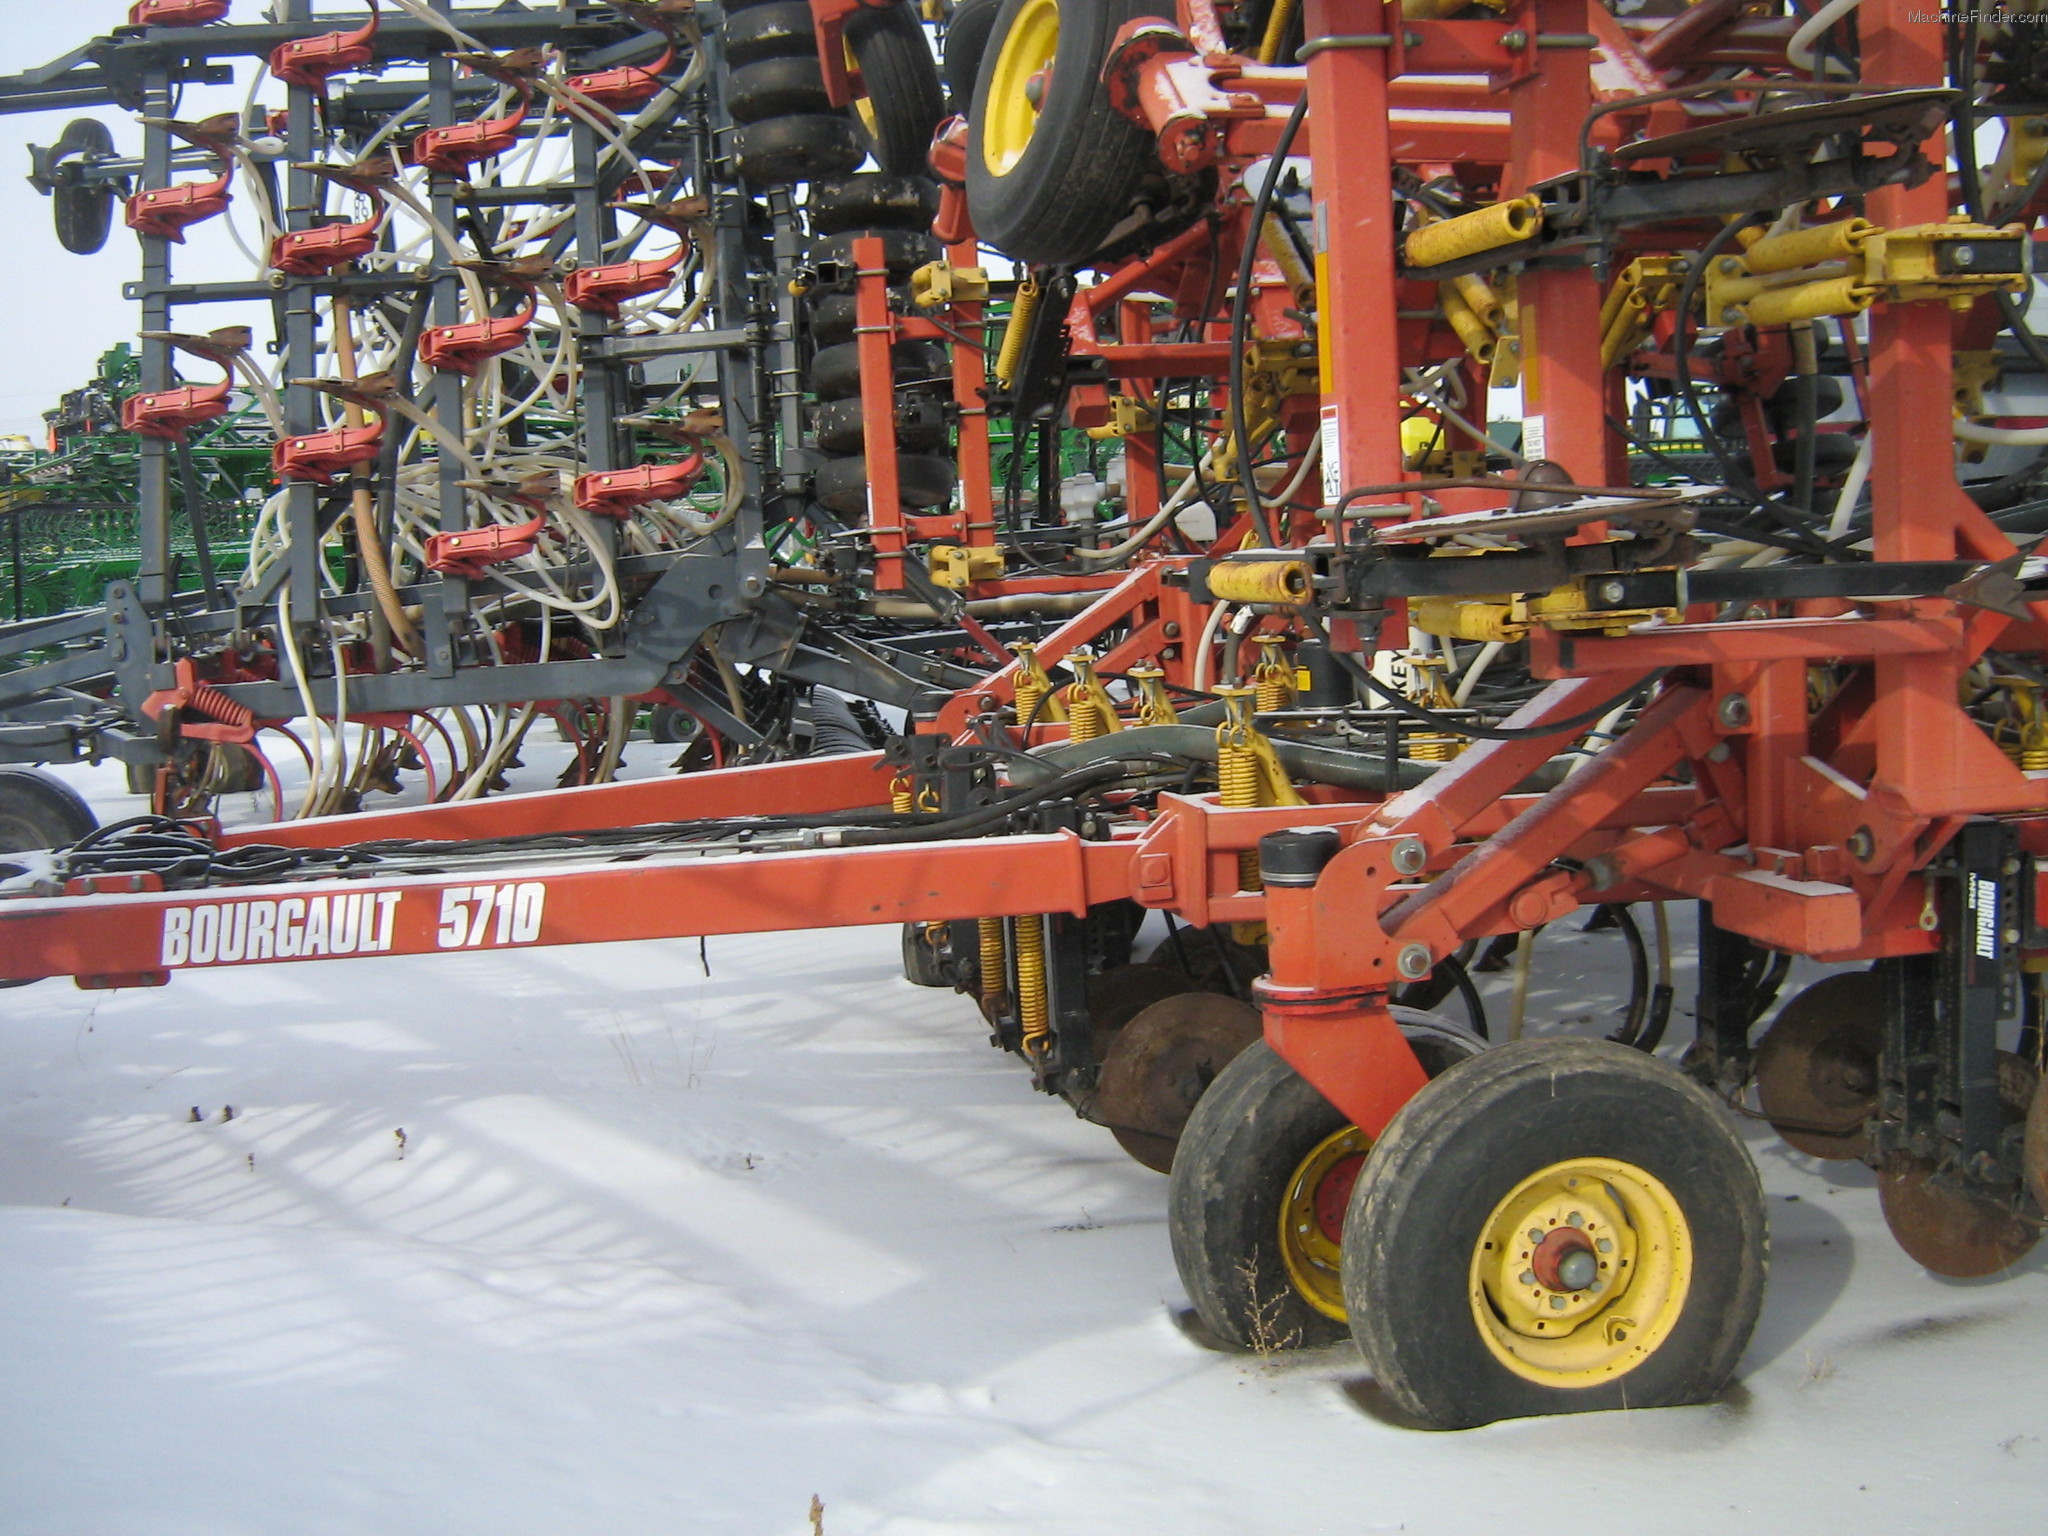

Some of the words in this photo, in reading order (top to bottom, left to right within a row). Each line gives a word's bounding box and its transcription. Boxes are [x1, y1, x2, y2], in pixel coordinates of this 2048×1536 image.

[161, 891, 402, 966] BOURGAULT
[437, 882, 546, 948] 5710
[1976, 880, 1995, 959] BOURGAULT
